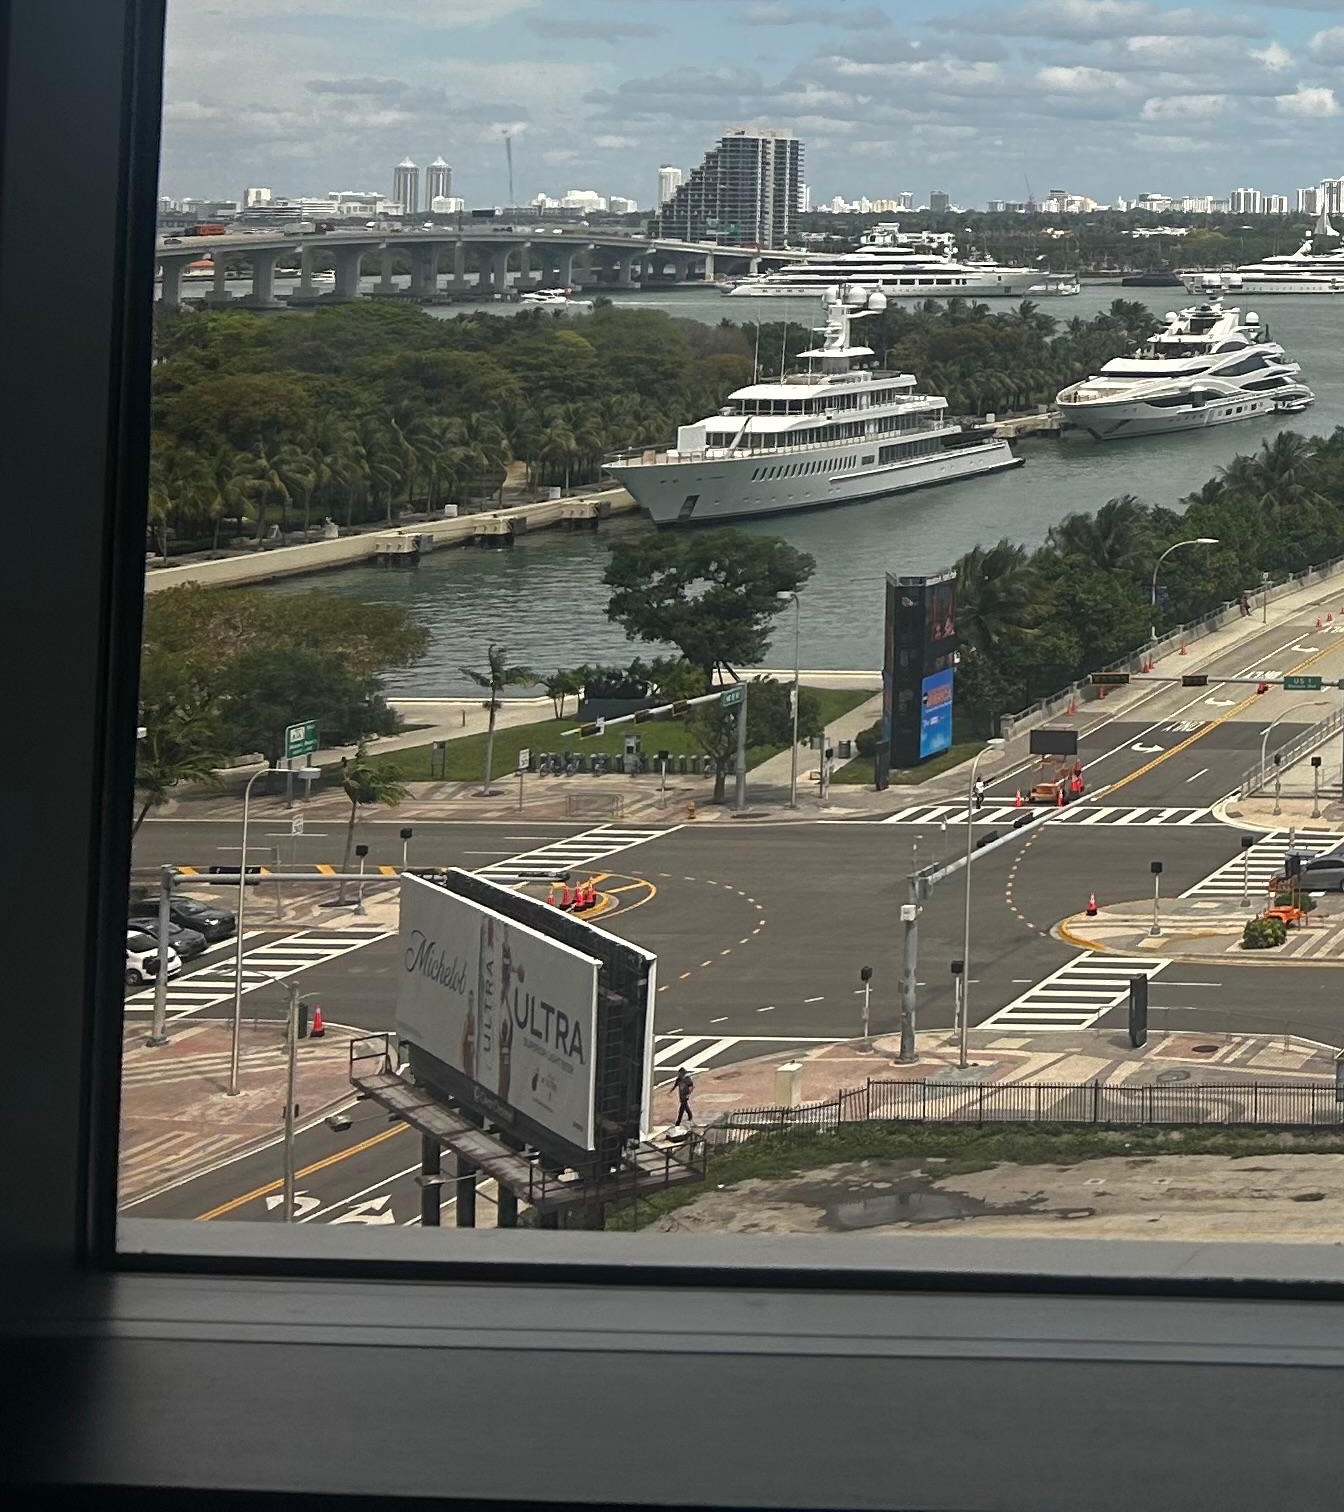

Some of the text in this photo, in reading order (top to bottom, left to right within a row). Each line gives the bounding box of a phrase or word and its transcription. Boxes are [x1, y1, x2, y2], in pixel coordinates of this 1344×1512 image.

[405, 929, 467, 996] Michelob
[483, 960, 494, 1053] ULTRA
[514, 986, 586, 1065] ULTRA
